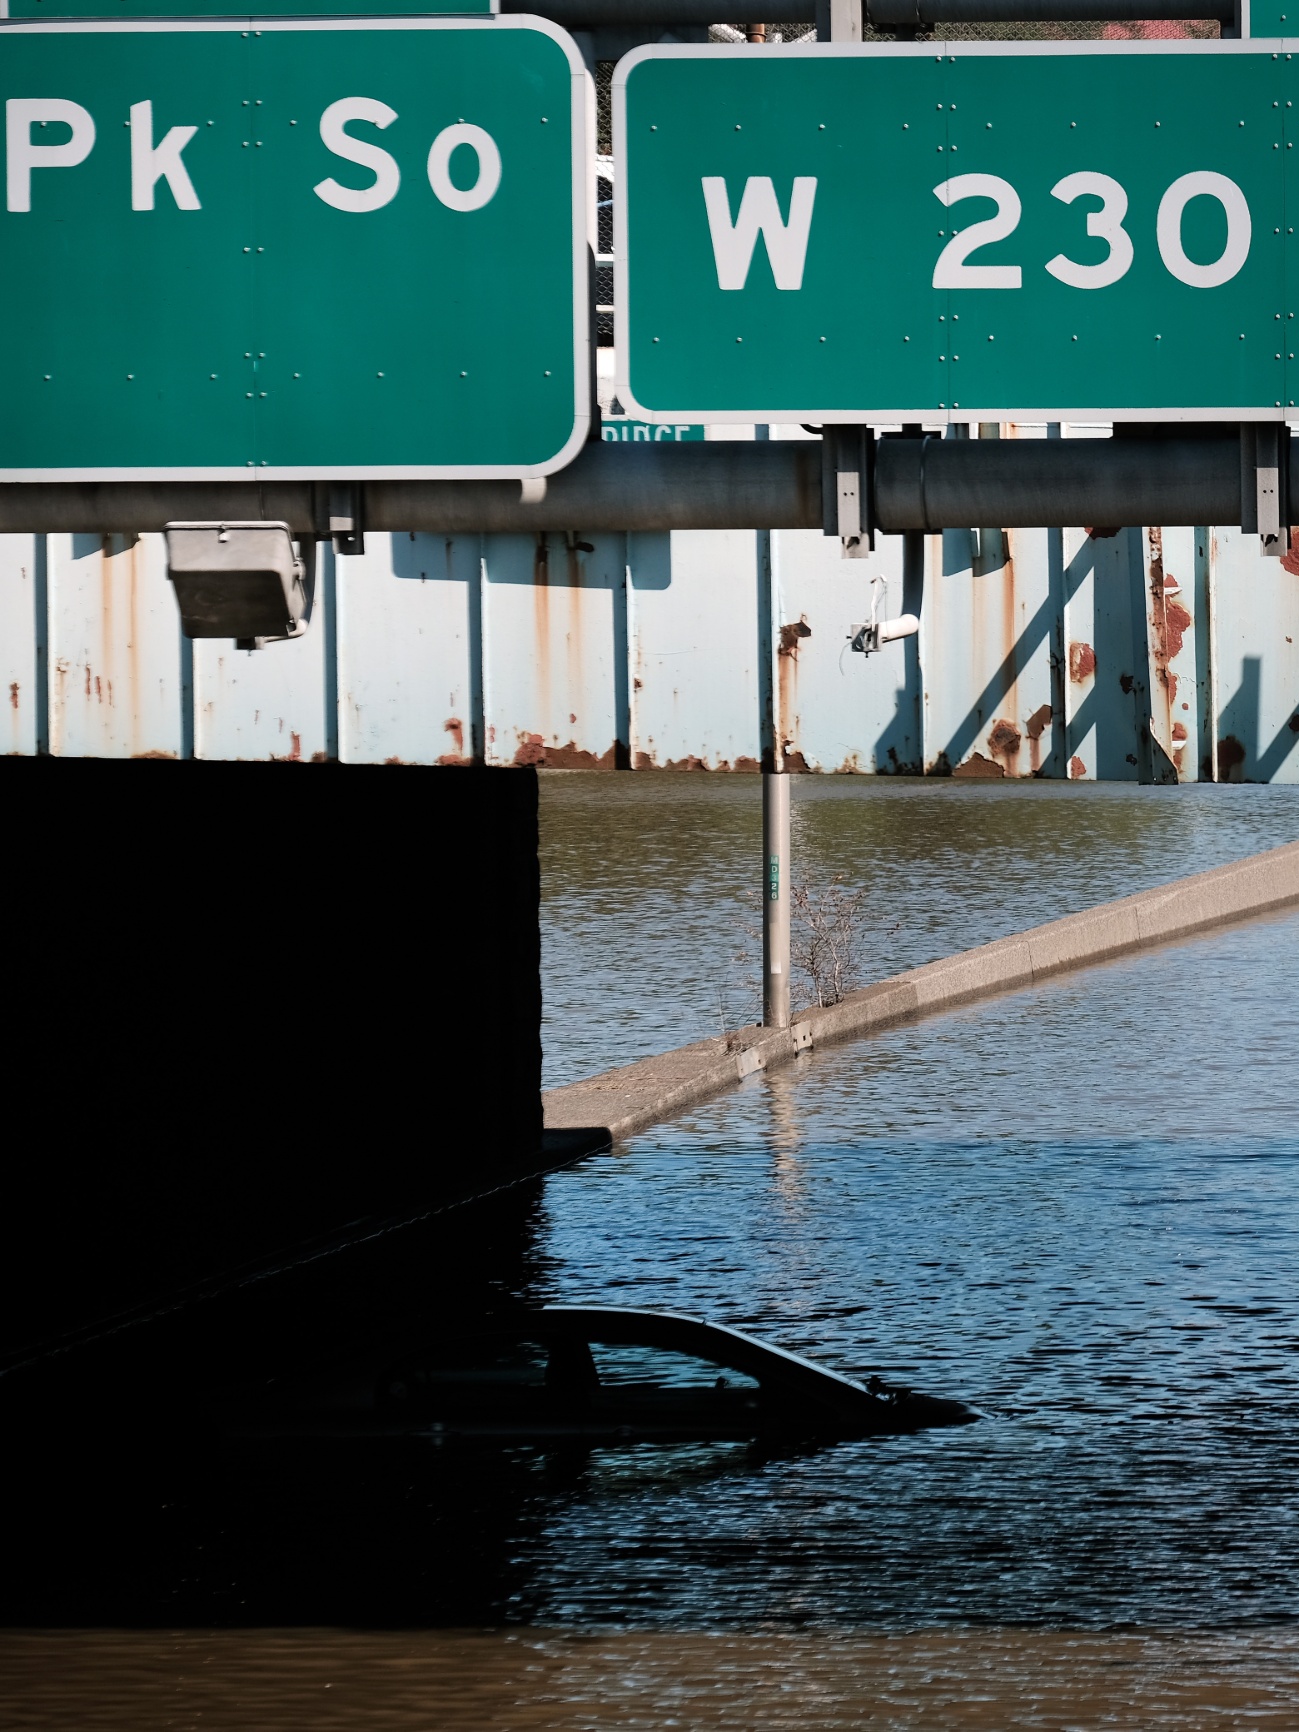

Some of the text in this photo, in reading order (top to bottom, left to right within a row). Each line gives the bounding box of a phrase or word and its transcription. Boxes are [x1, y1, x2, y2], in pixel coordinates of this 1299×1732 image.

[5, 96, 502, 213] Pk So
[701, 176, 818, 291] W
[931, 170, 1252, 290] 230
